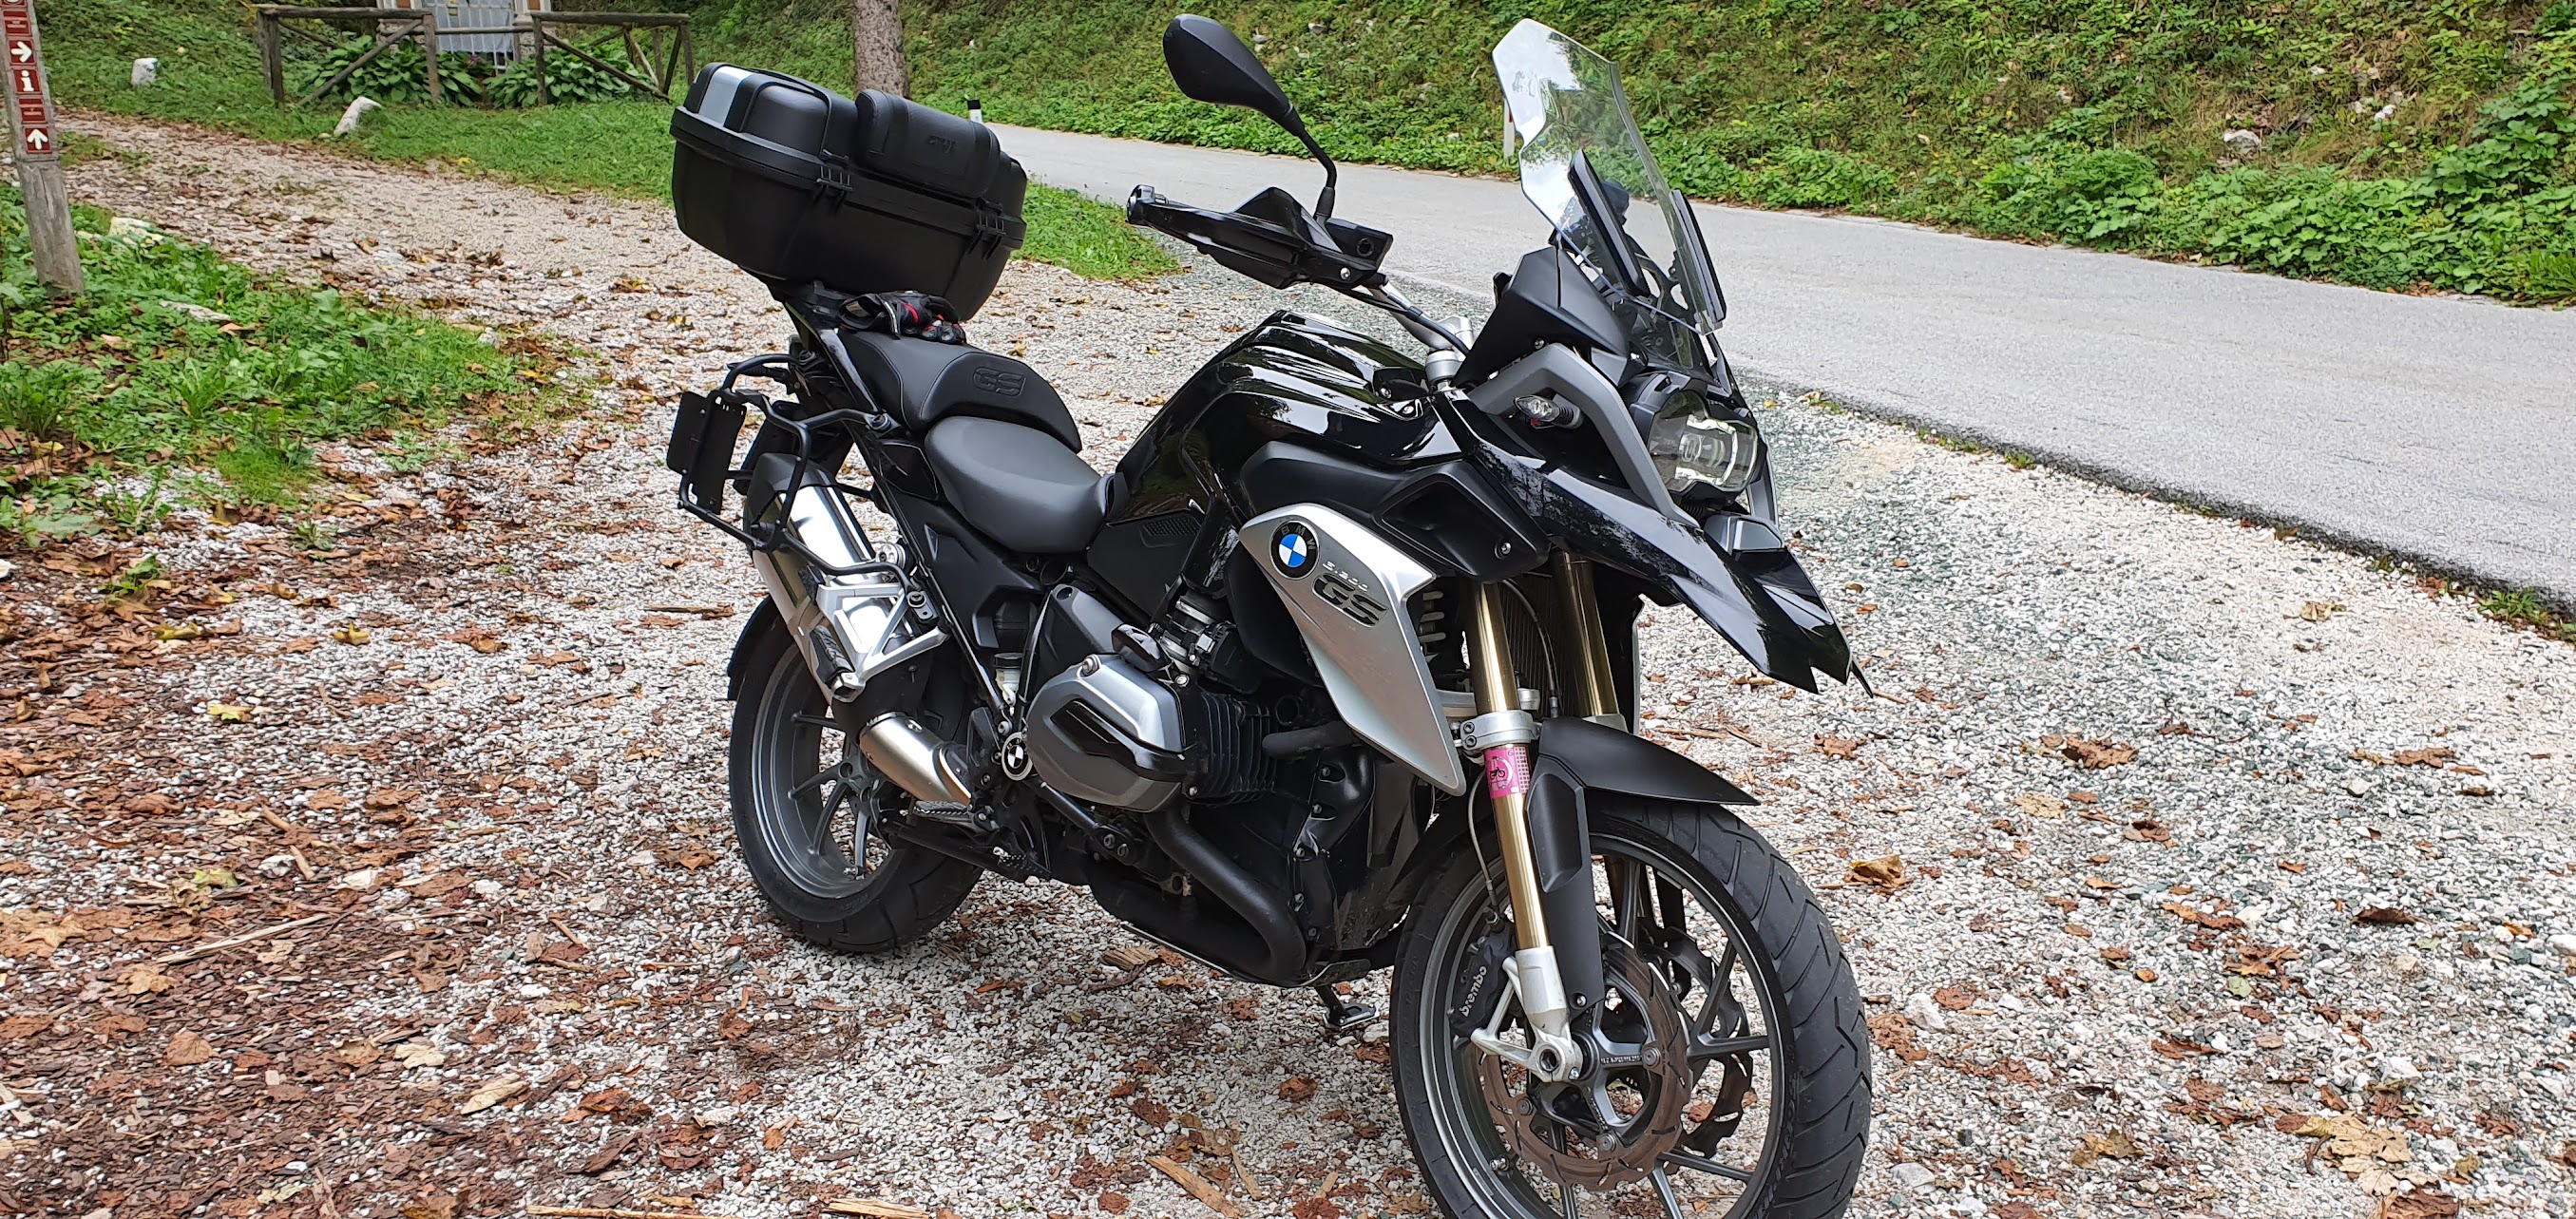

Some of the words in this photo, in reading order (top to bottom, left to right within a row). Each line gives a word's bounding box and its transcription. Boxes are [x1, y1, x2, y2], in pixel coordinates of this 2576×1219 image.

[21, 69, 34, 92] i
[973, 366, 1026, 396] GS
[1280, 524, 1317, 550] BMW
[1312, 573, 1389, 627] GS
[1459, 965, 1487, 1018] brembo
